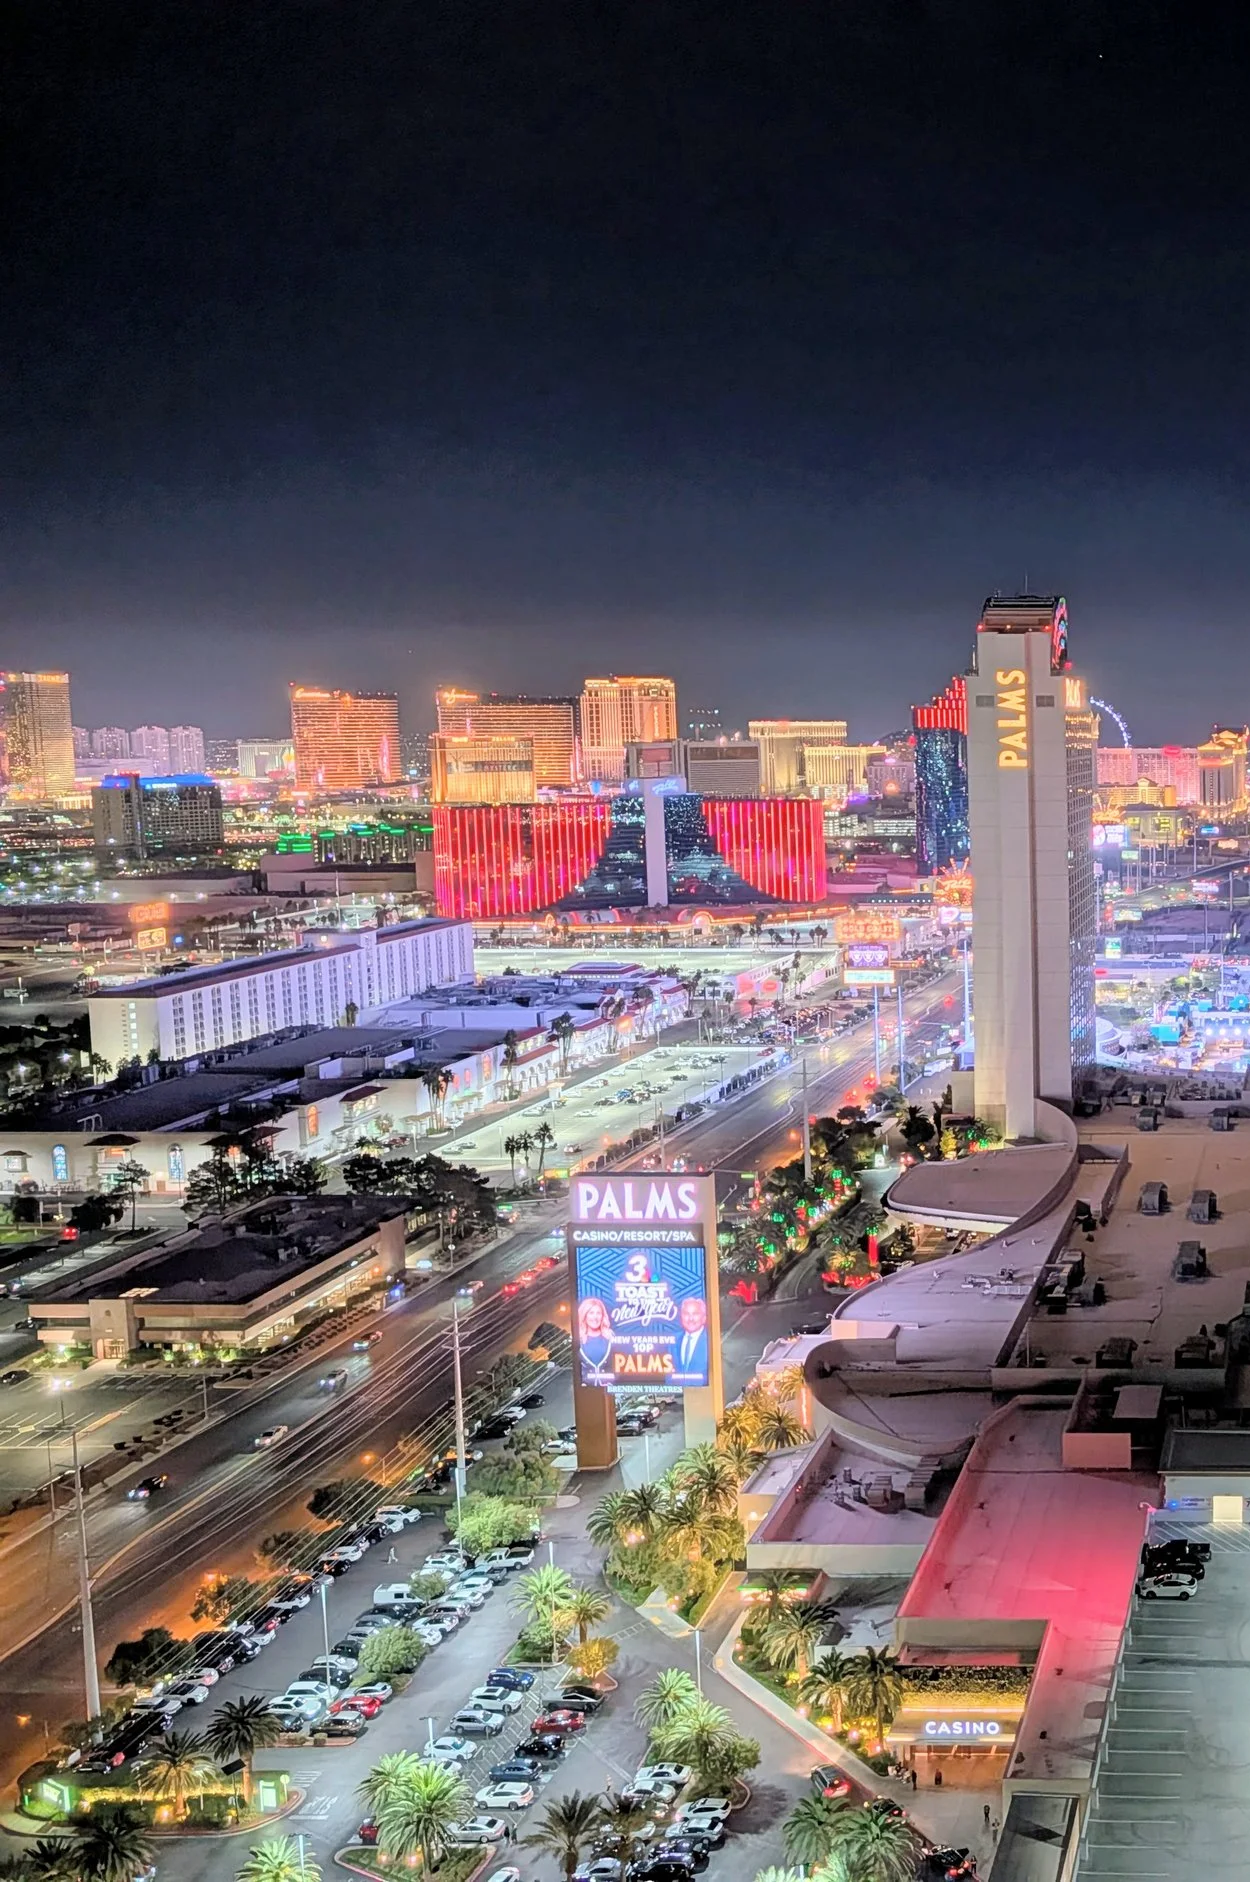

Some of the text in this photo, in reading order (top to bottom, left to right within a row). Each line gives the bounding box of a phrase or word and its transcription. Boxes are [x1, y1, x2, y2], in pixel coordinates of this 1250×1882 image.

[996, 669, 1028, 768] PALMS
[578, 1182, 697, 1220] PALMS
[573, 1230, 696, 1243] CASINO/RESORT/SPA
[625, 1254, 648, 1283] 3
[615, 1286, 668, 1299] TOAST
[611, 1336, 631, 1344] NEW
[659, 1336, 676, 1344] EVE
[633, 1344, 655, 1353] 10P
[607, 1385, 683, 1393] BRENDEN THEATRES
[925, 1721, 1001, 1736] CASINO
